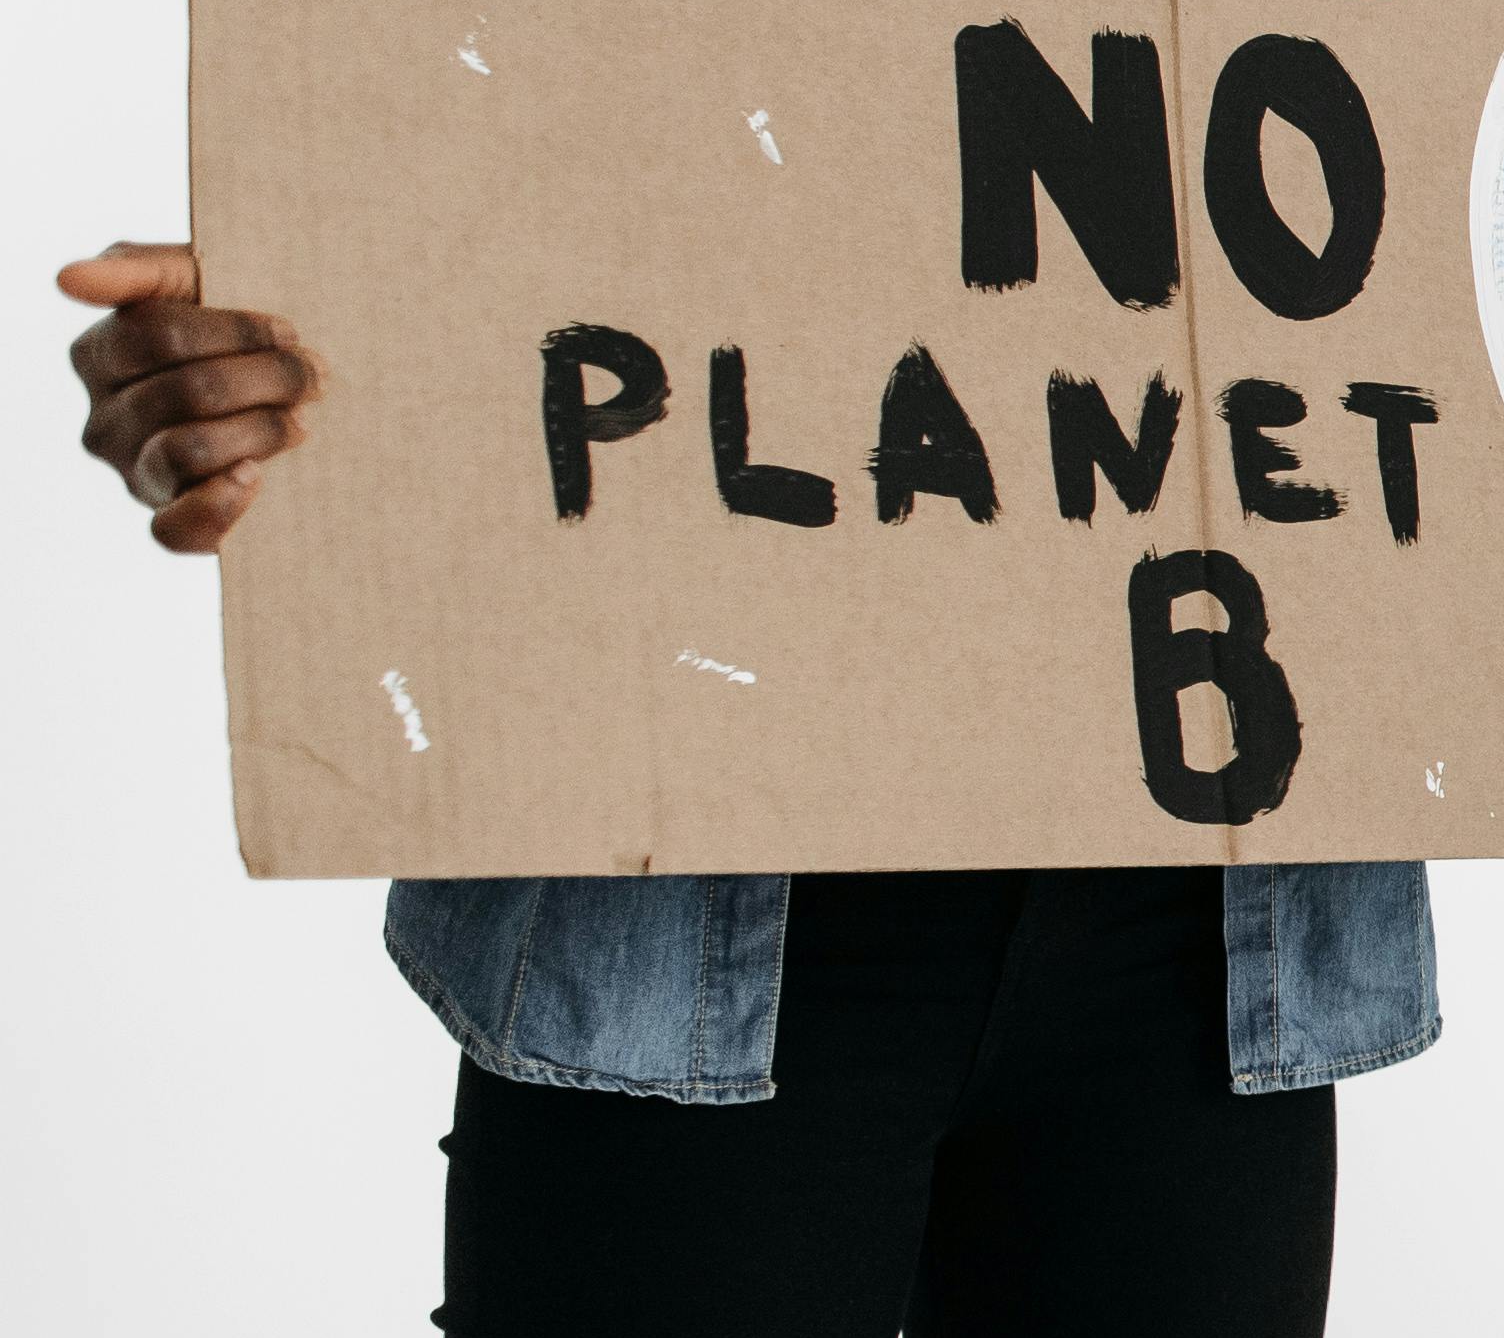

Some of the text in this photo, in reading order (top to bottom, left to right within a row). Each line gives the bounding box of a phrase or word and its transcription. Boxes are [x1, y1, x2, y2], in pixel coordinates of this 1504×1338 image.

[953, 15, 1388, 323] NO
[538, 319, 1441, 547] PLANET
[1126, 545, 1305, 828] B
